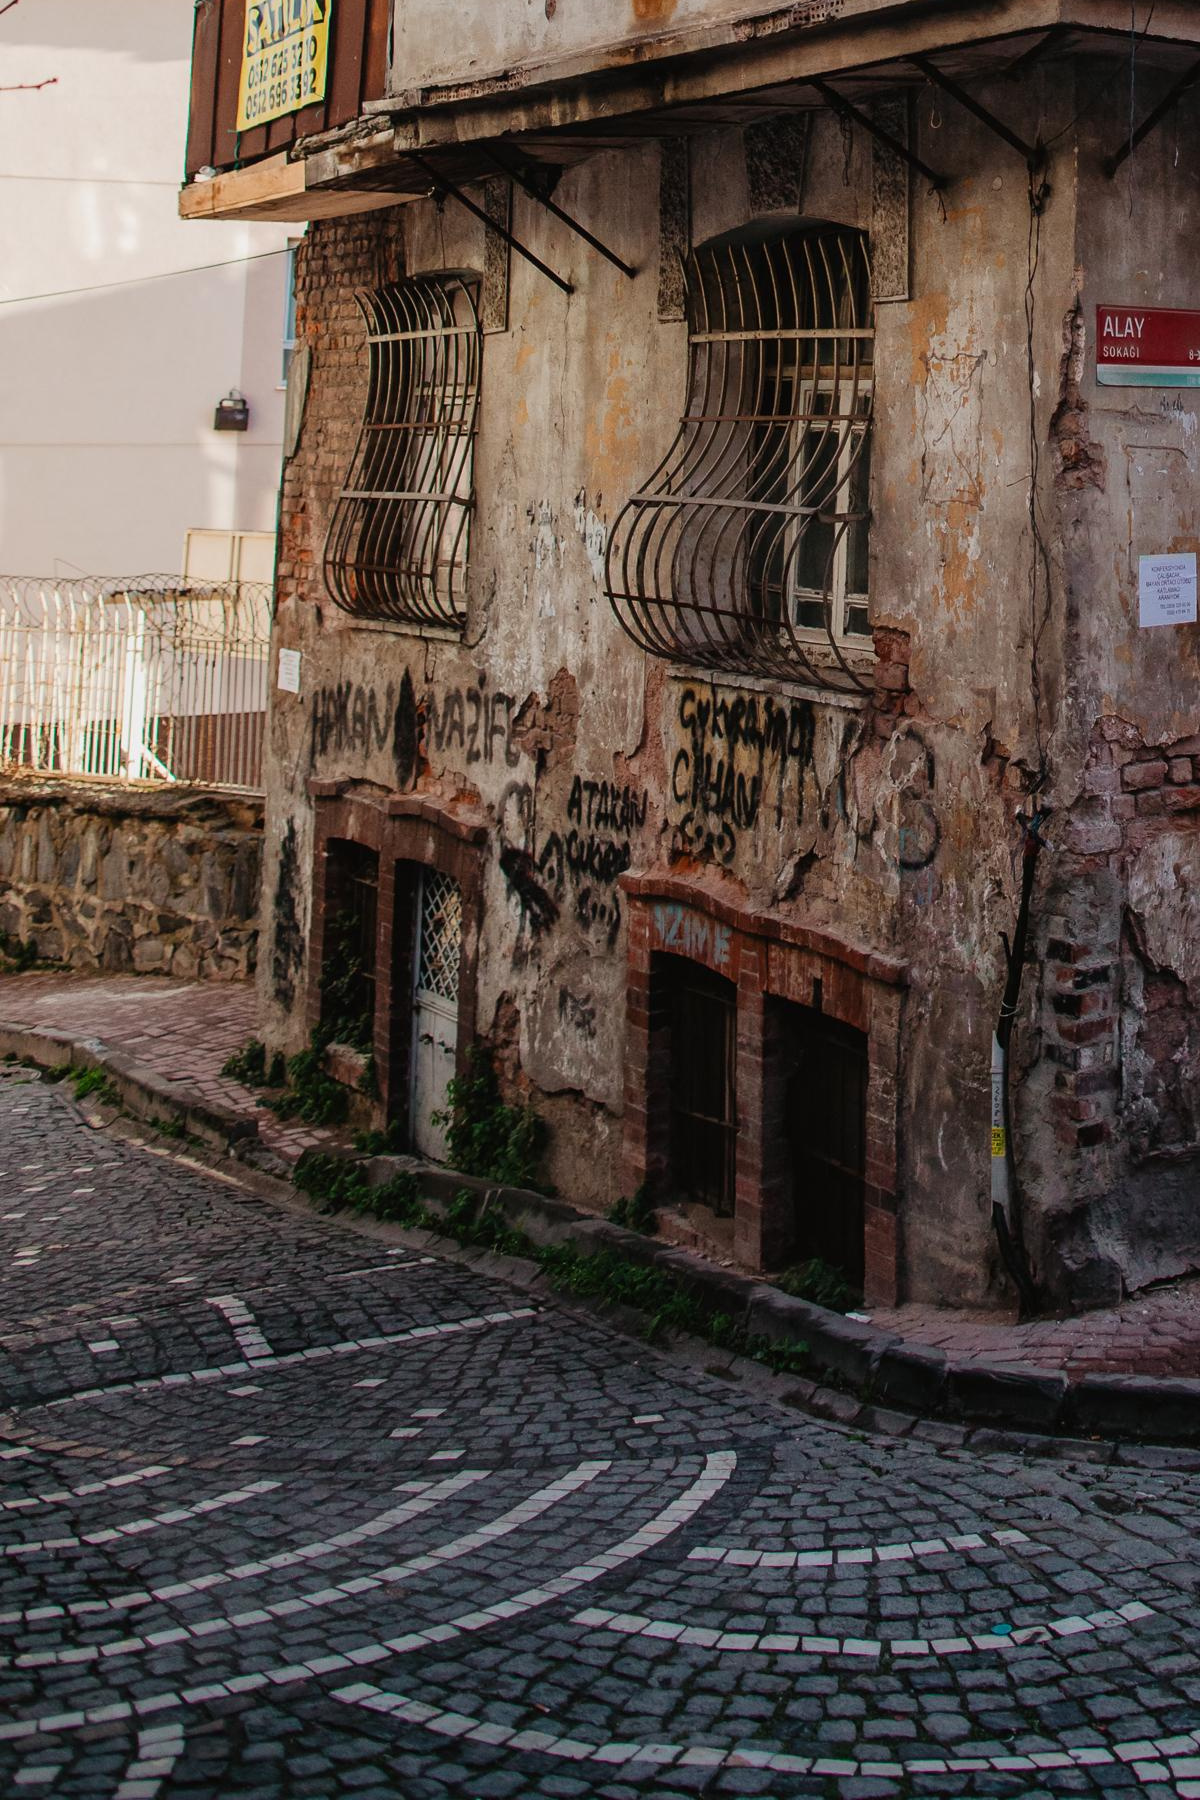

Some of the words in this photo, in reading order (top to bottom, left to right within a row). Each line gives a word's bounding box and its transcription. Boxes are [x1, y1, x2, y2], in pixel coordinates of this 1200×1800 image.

[271, 48, 288, 78] 625
[306, 35, 317, 62] 10
[303, 67, 317, 96] 92
[1103, 315, 1145, 338] ALAY
[1103, 345, 1140, 358] SOKAĞI
